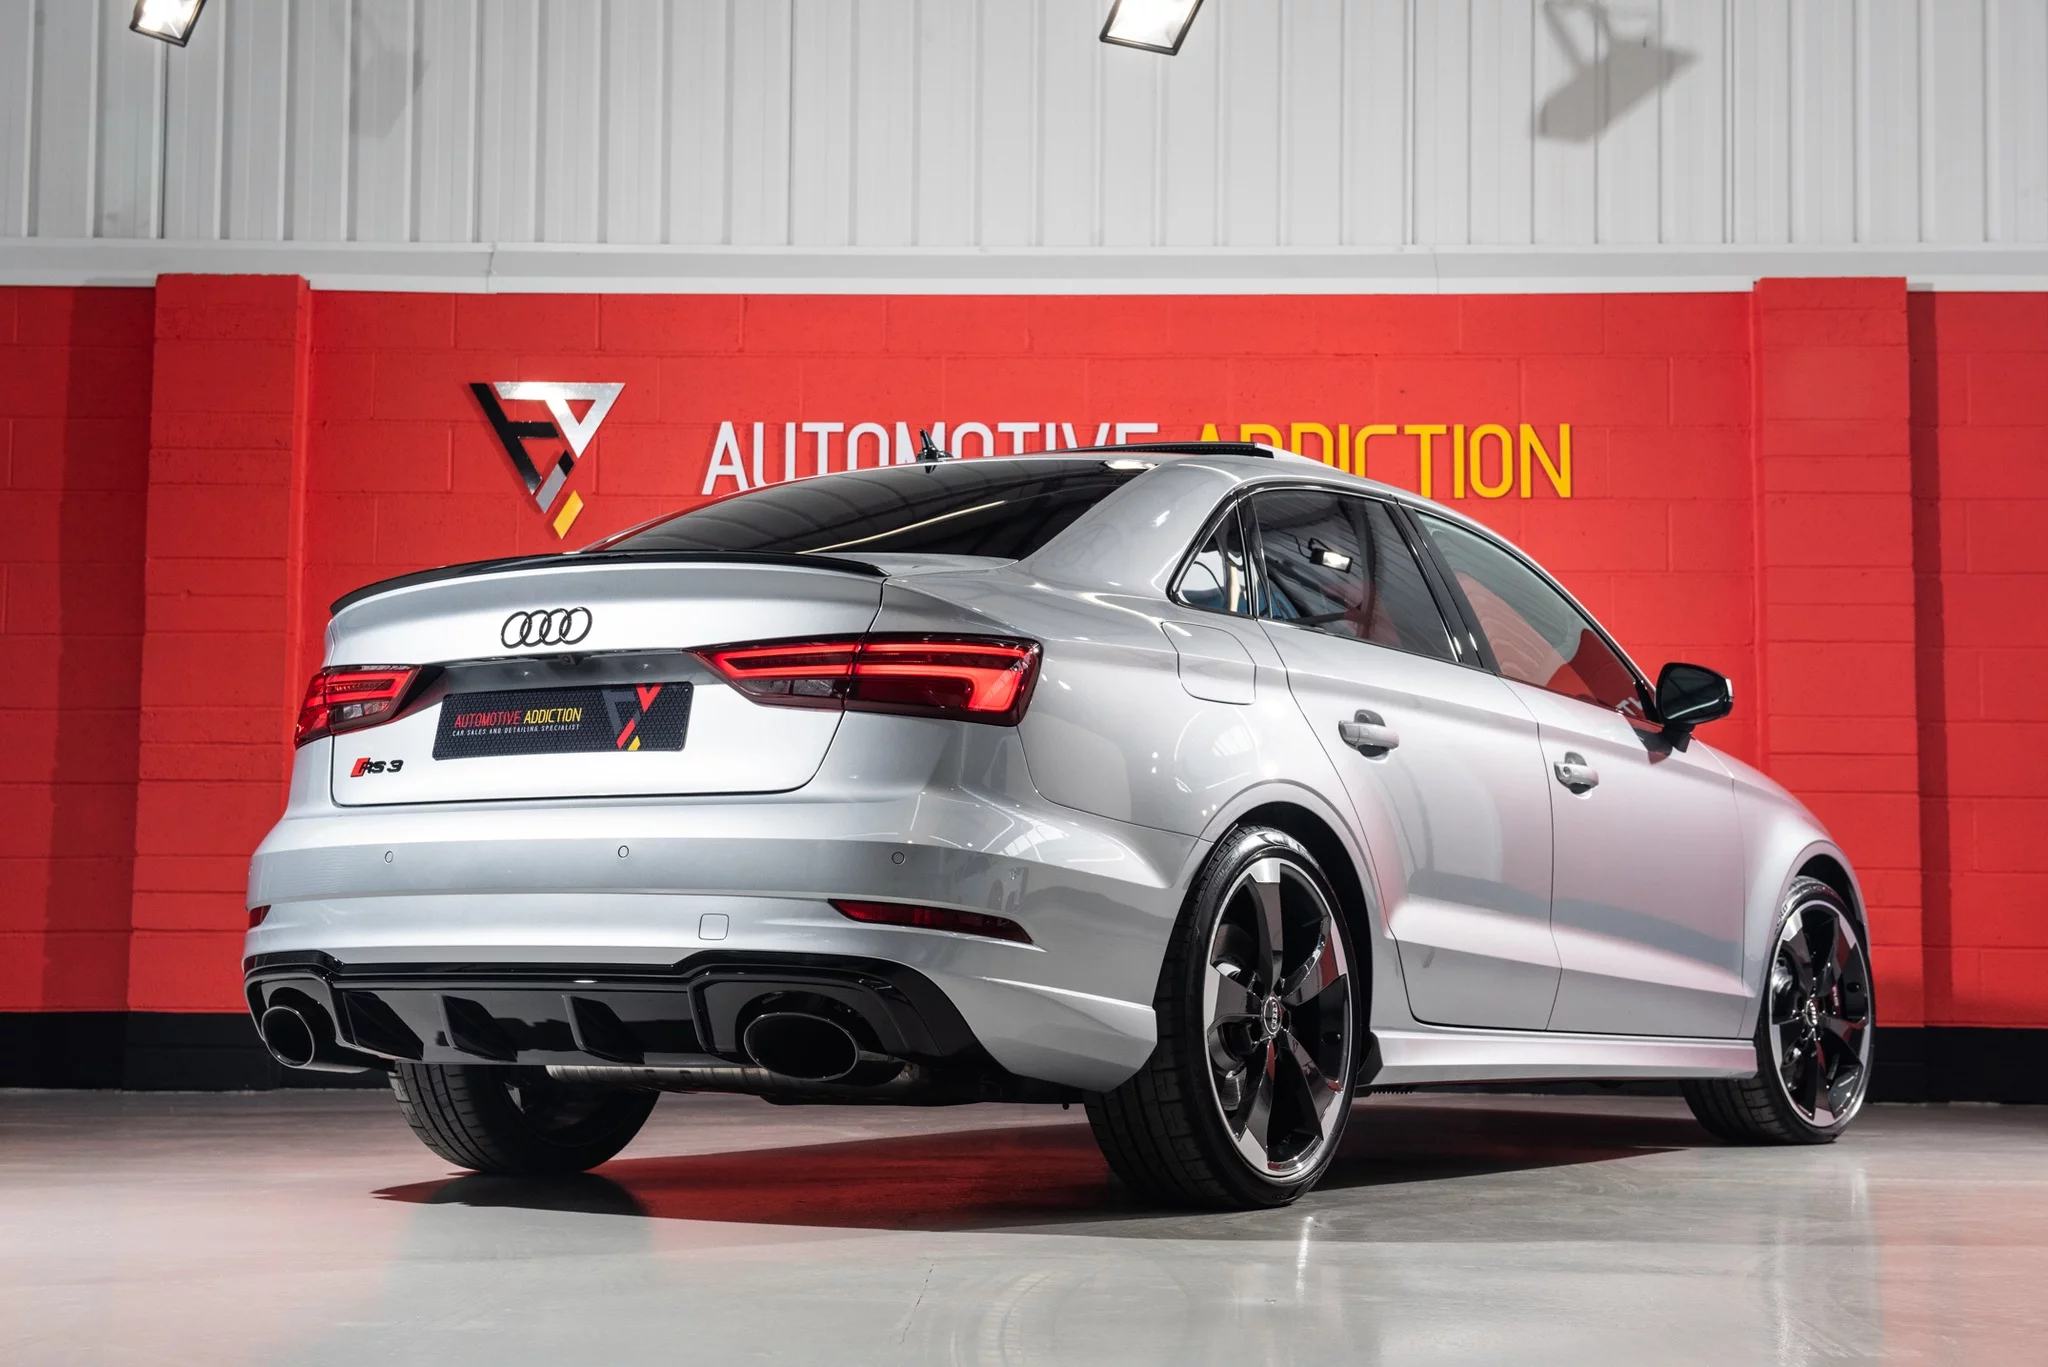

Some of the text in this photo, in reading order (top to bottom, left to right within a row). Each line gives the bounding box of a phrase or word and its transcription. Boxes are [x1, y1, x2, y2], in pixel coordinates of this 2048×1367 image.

[1199, 423, 1571, 498] ICTION
[454, 708, 582, 728] AUTOMOTIVE ADDICTION
[467, 728, 486, 736] SALES
[504, 726, 538, 734] DETAILING
[541, 724, 580, 732] SPECIALIST
